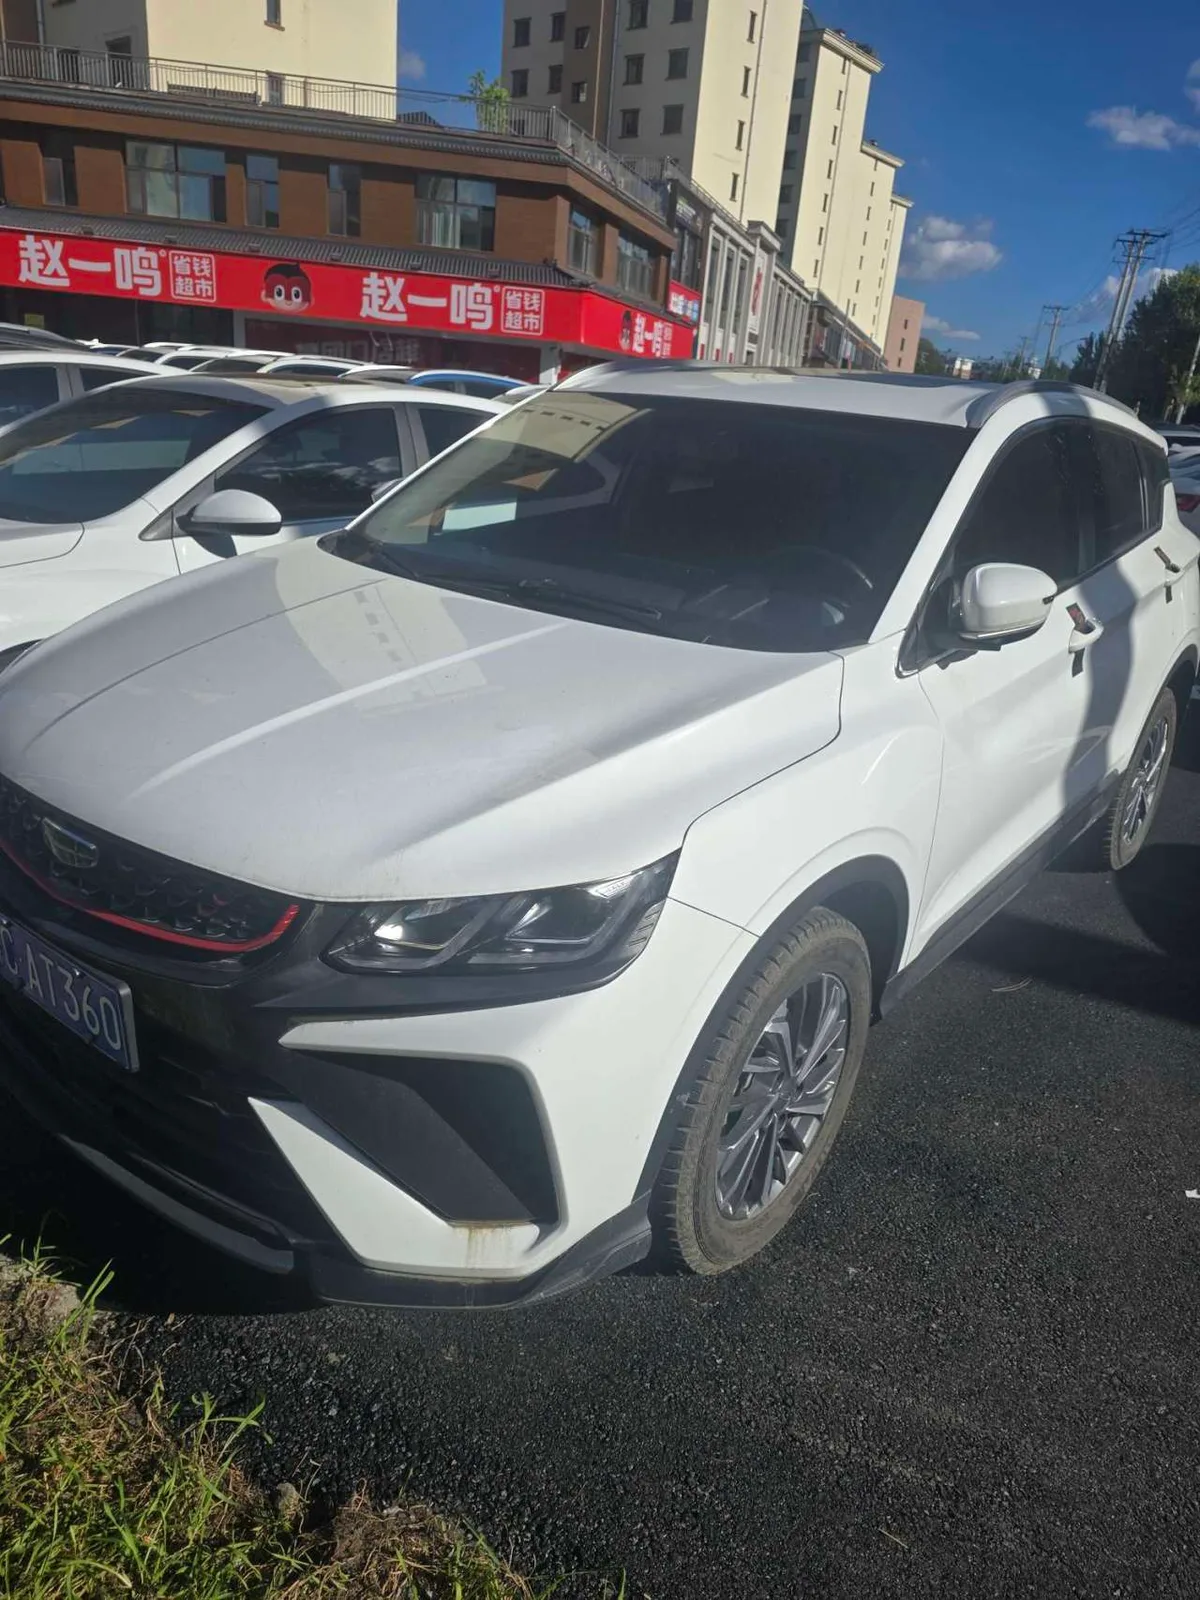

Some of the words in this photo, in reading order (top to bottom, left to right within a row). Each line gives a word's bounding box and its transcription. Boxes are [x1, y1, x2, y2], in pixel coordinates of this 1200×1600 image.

[18, 234, 162, 296] 赵一鸣
[173, 255, 211, 278] 省钱
[175, 278, 213, 298] 超市
[359, 272, 493, 330] 赵一鸣
[504, 291, 540, 312] 省钱
[504, 312, 540, 332] 超市
